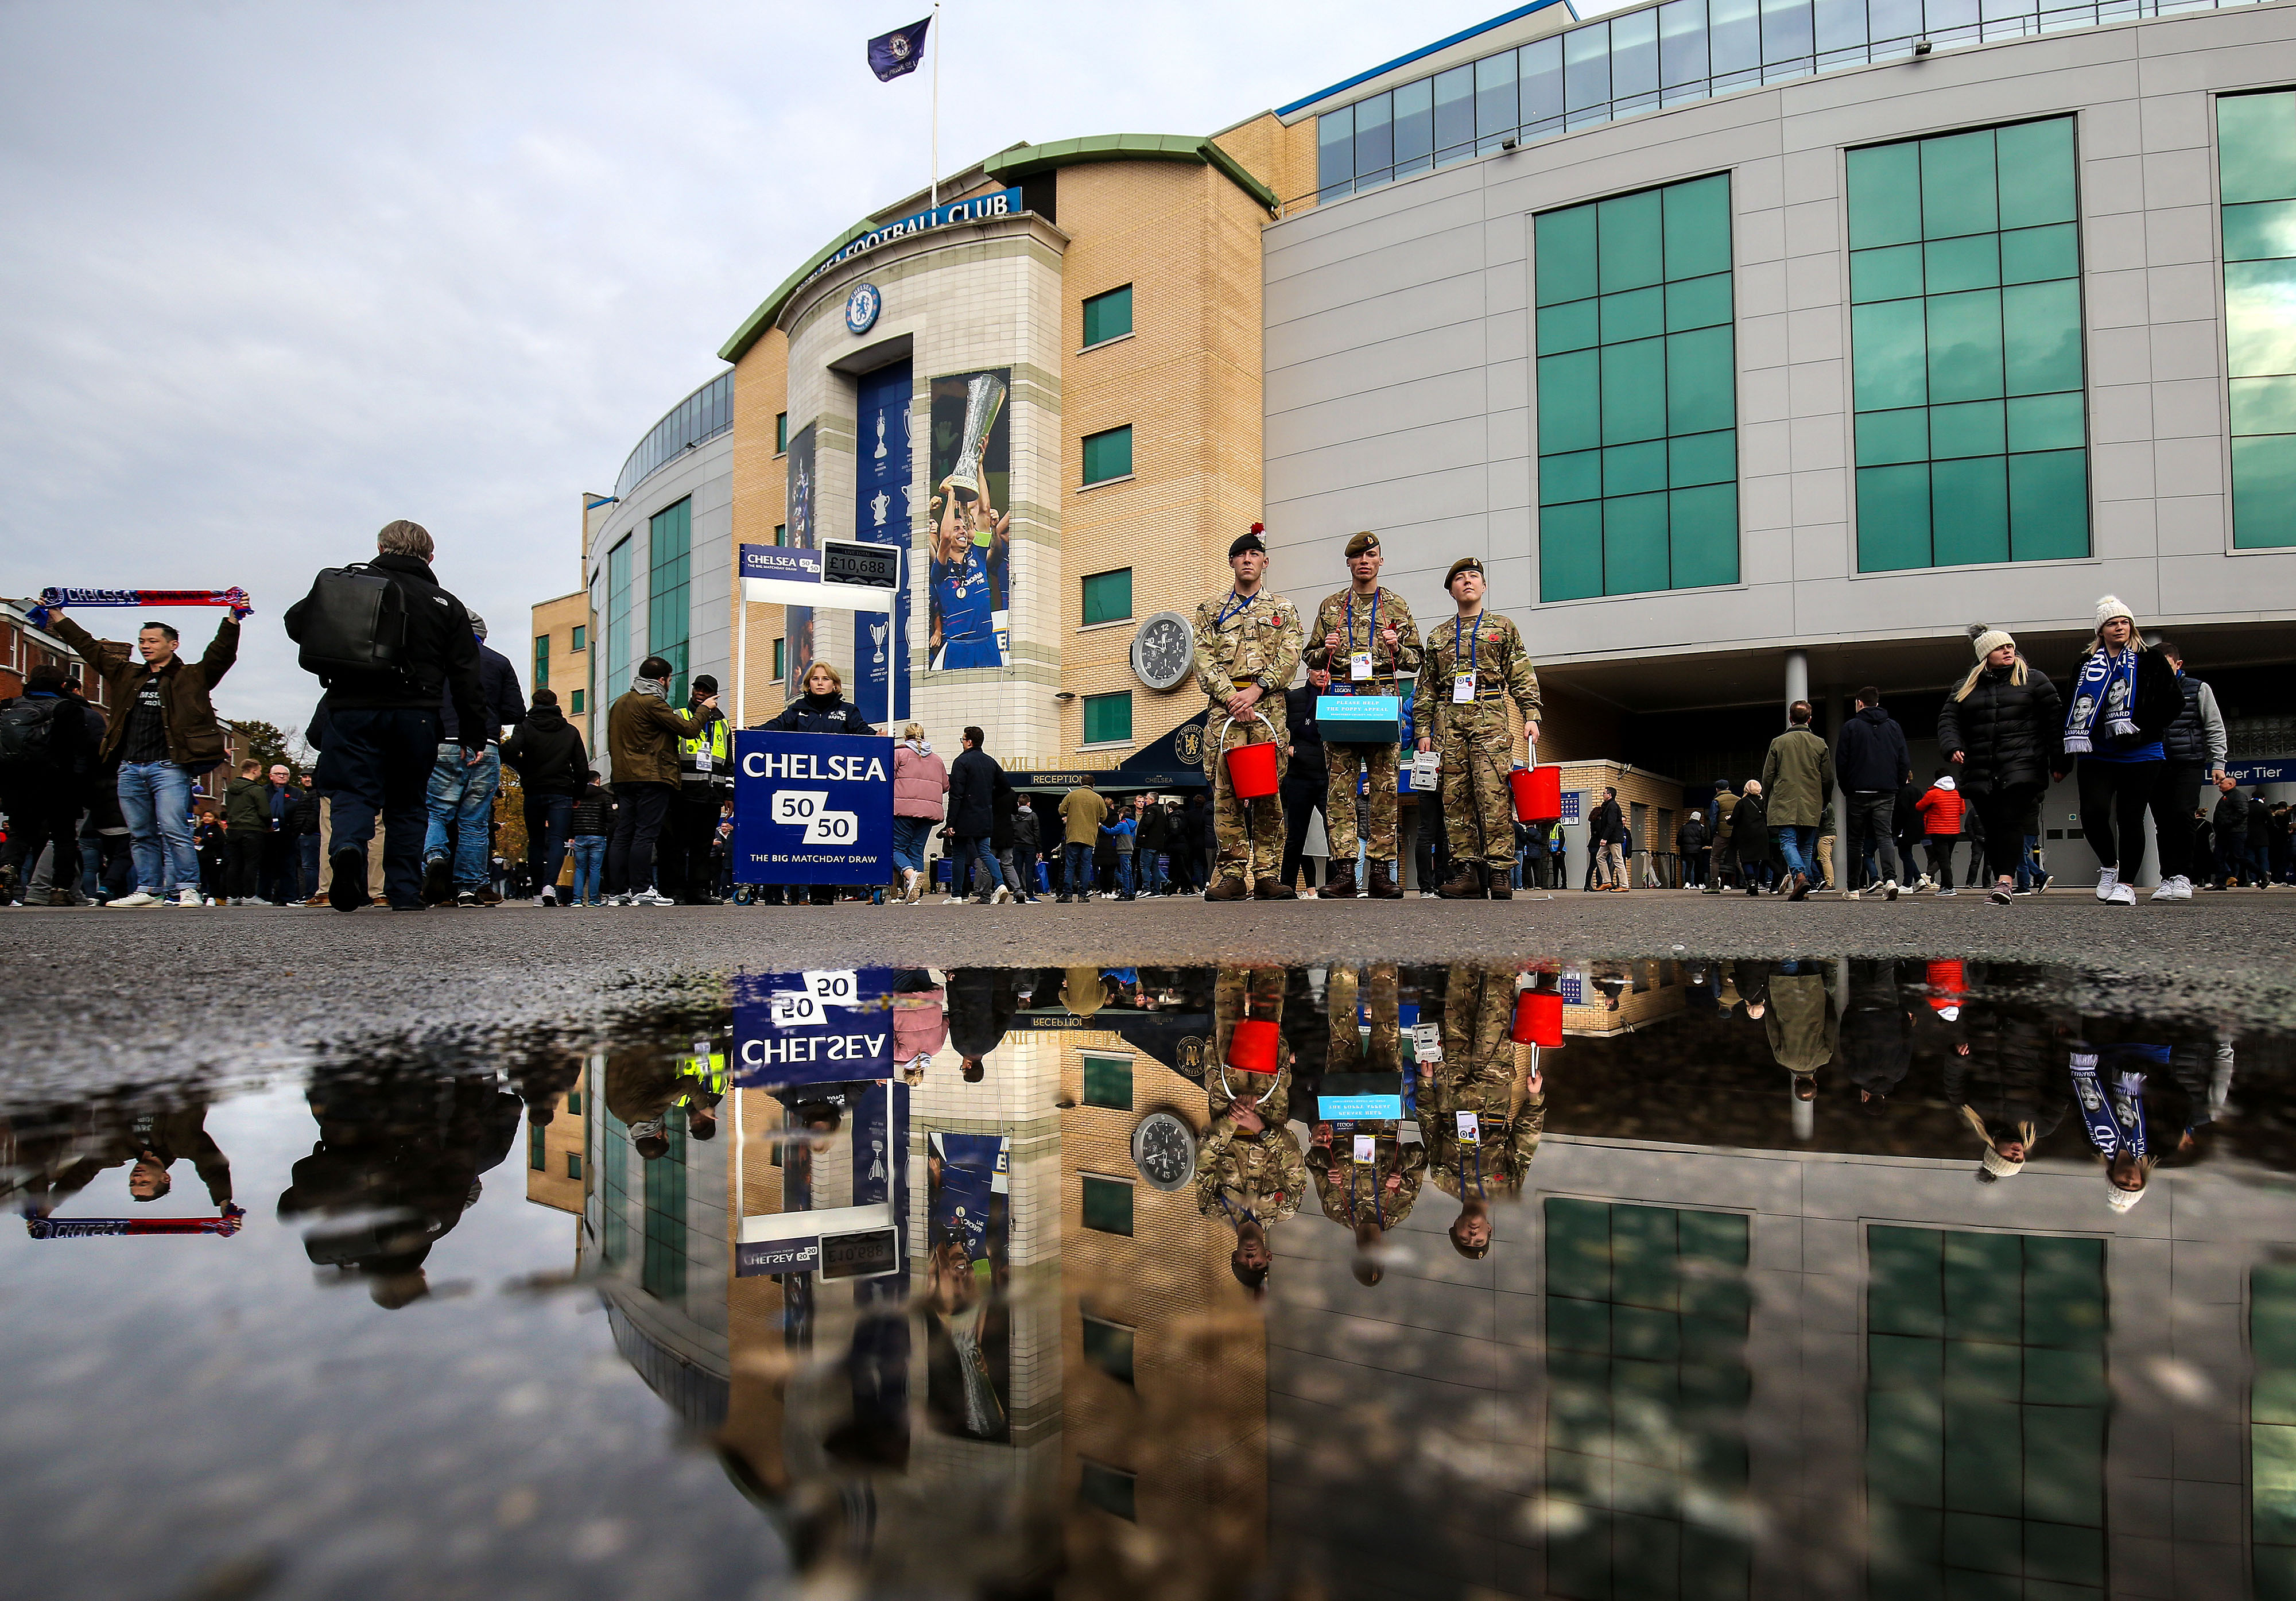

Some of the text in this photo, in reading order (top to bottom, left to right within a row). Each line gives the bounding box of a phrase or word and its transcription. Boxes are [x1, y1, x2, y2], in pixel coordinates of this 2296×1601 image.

[851, 284, 872, 300] CHELSEA
[747, 554, 797, 567] CHELSEA
[829, 556, 885, 573] £10,688
[1181, 726, 1201, 735] CHELSEA
[742, 752, 887, 781] CHELSEA
[1001, 756, 1120, 772] MILLENNIUM
[2205, 767, 2282, 780] Lwer Tier
[782, 798, 814, 817] 50
[817, 819, 849, 837] 50
[771, 854, 788, 862] BIG
[792, 855, 846, 863] MATCHDAY
[848, 855, 877, 863] DRAW
